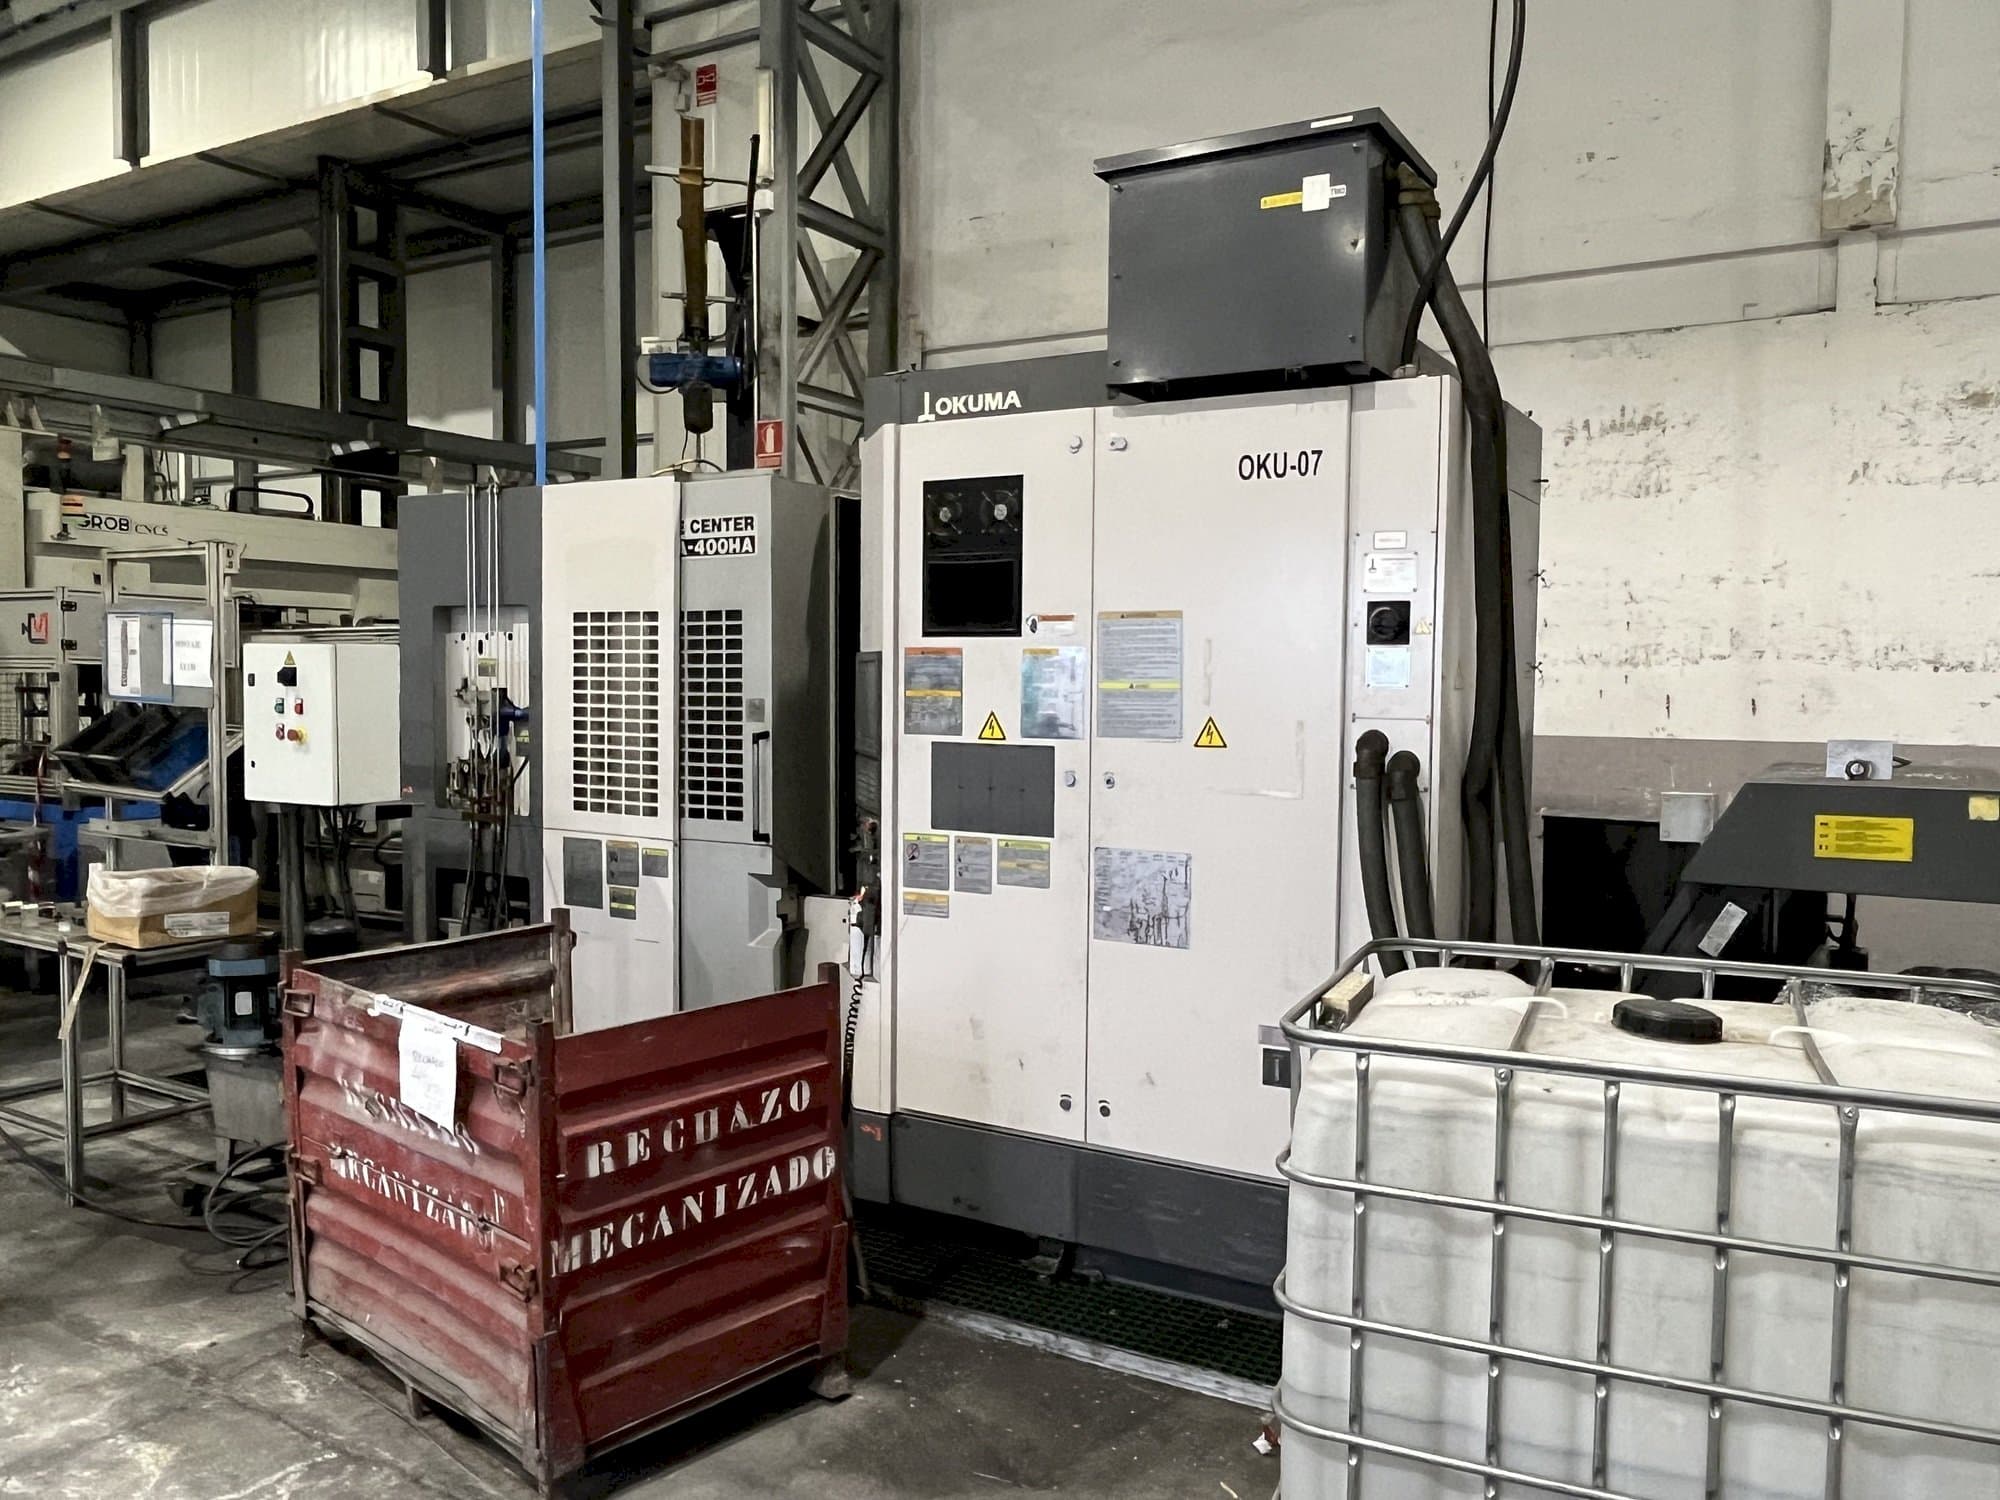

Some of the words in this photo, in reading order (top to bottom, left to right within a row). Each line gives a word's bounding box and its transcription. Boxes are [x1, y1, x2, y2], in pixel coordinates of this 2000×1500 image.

[935, 390, 1022, 416] OKUMA
[1238, 449, 1323, 481] OKU-07
[690, 515, 755, 534] CENTER
[586, 1079, 811, 1179] RECHAZO
[551, 1145, 836, 1278] MECANIZADO
